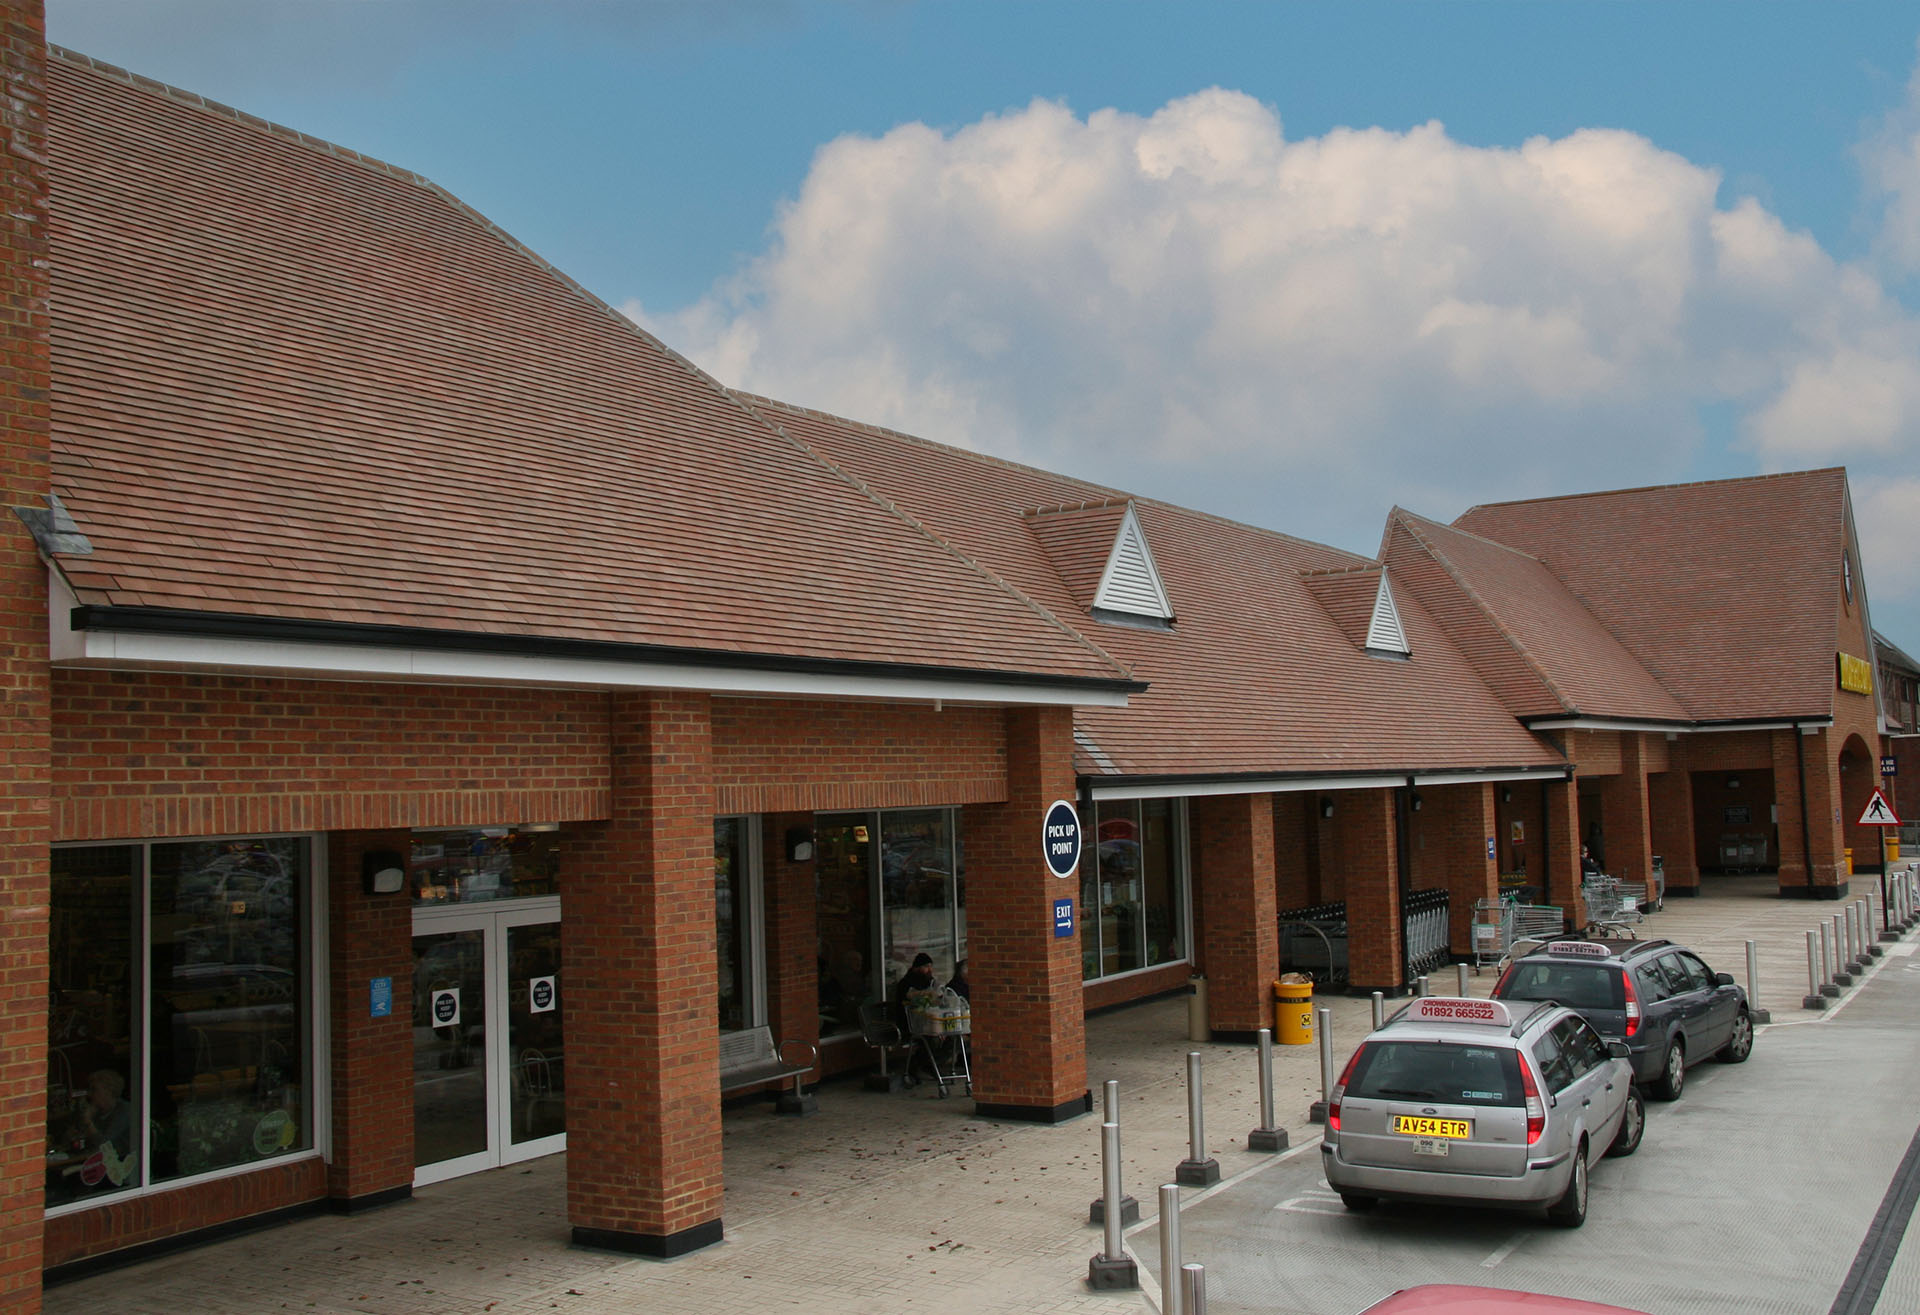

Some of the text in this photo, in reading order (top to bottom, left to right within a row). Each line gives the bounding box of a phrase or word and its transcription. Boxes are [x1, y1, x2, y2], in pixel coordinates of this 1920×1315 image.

[1048, 824, 1075, 838] PICK UP
[1052, 841, 1072, 855] POINT
[1056, 905, 1071, 918] EXIT
[1423, 1000, 1492, 1010] CROWBOROUGH CABS
[1421, 1006, 1494, 1020] 01892 665522
[1402, 1118, 1436, 1133] AV54
[1440, 1121, 1467, 1136] ETR
